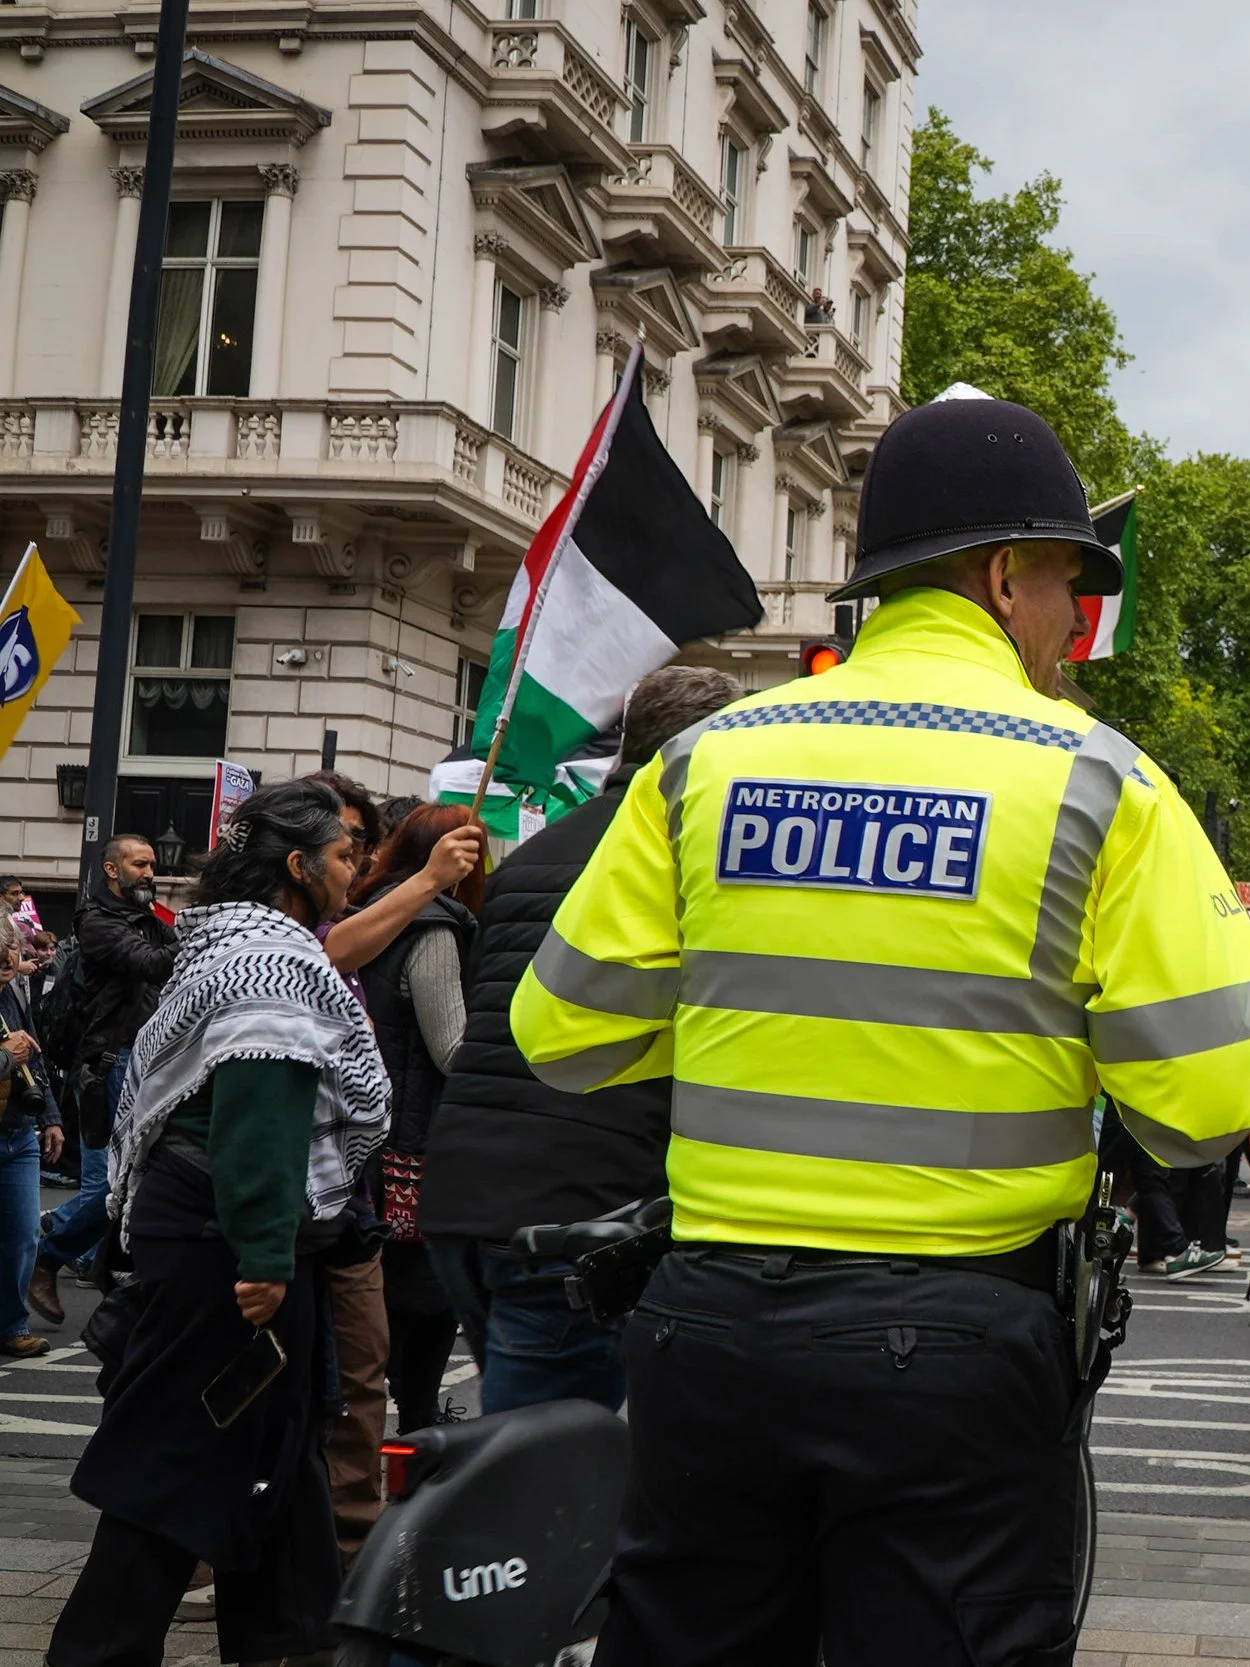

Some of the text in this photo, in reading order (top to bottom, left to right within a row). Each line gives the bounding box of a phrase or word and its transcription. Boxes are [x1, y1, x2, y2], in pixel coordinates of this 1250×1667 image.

[736, 787, 978, 821] METROPOLITAN
[725, 813, 973, 887] POLICE
[443, 1557, 528, 1602] Lime
